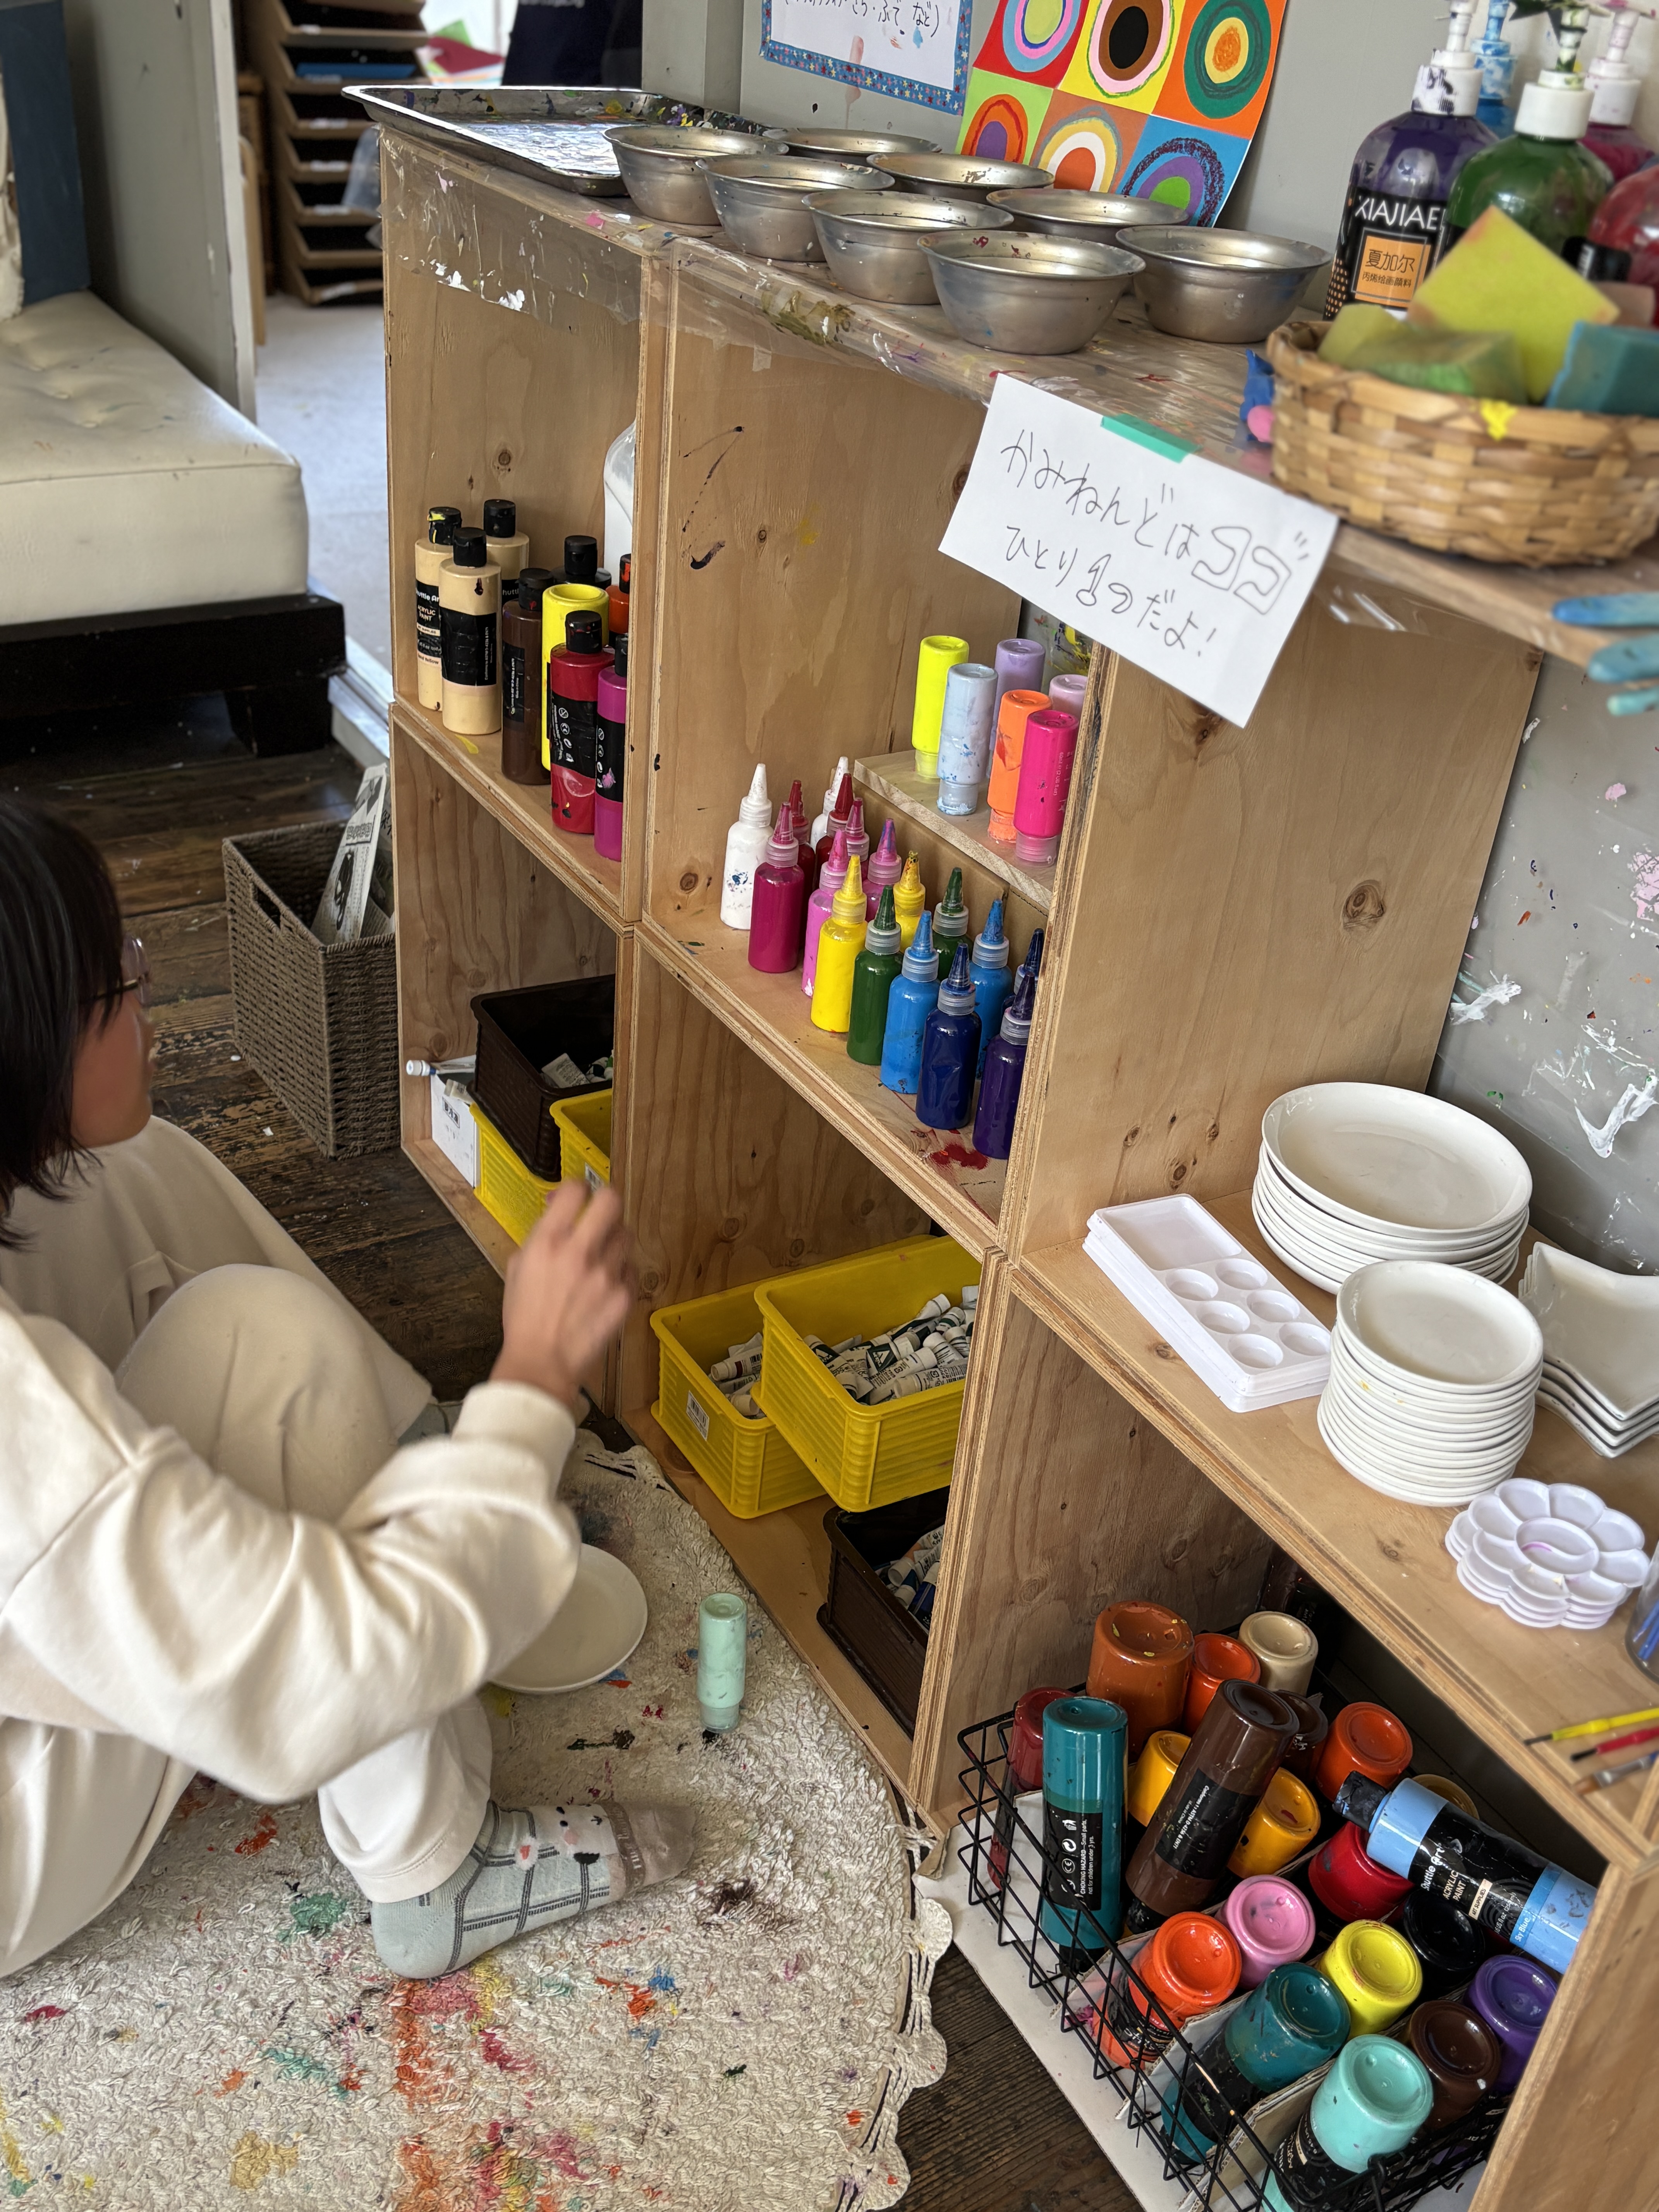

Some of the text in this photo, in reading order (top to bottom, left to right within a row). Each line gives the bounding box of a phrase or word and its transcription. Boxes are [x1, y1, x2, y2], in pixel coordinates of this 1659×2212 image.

[1365, 249, 1415, 273] 夏加尔
[1362, 272, 1412, 288] 丙烯绘画颜料
[1443, 1870, 1459, 1900] ACRYLIC
[1453, 1880, 1467, 1901] PAINT
[1475, 1888, 1486, 1909] SUPPLIES
[1515, 1917, 1530, 1942] Sky Blue
